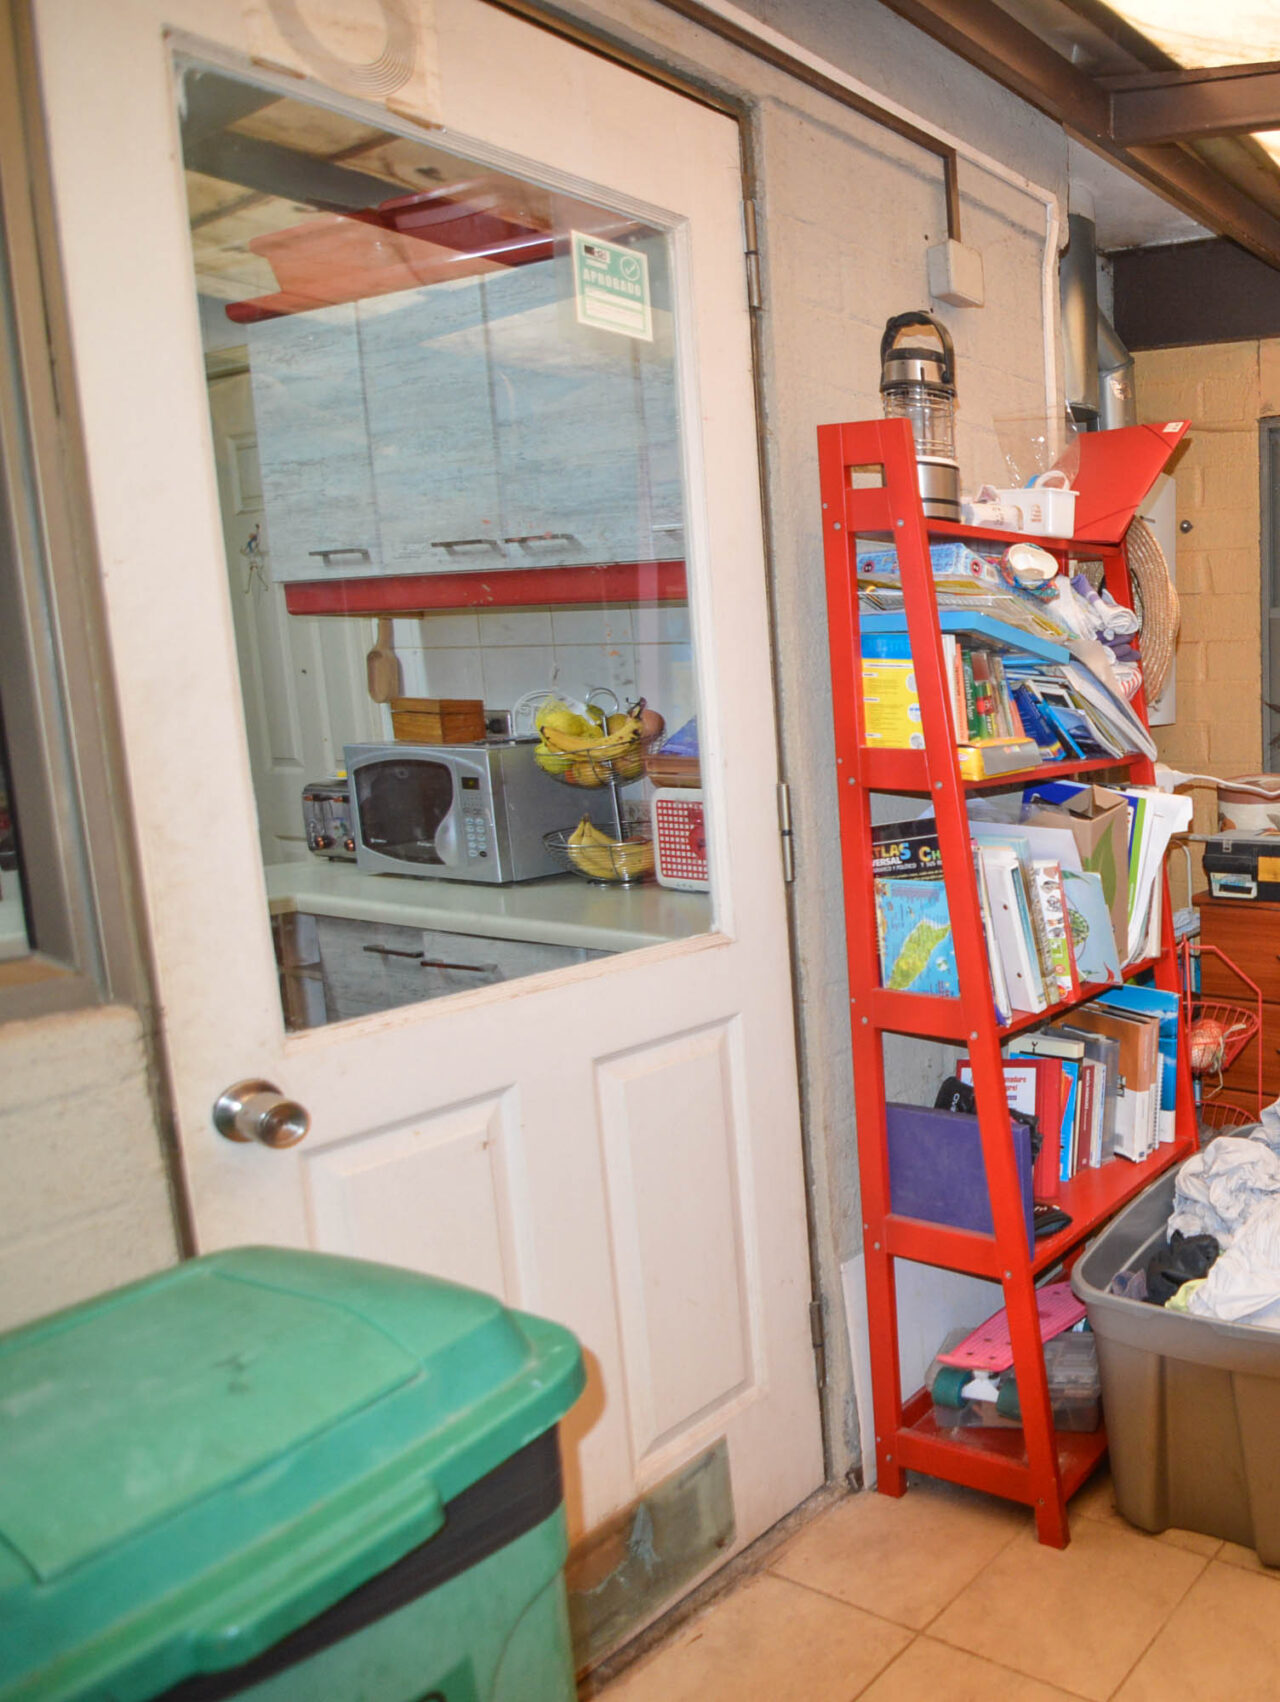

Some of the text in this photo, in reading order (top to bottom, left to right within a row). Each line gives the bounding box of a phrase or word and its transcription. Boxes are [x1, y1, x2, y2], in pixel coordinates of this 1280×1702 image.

[583, 267, 642, 297] APROBADO
[963, 664, 974, 720] Cambridge
[872, 857, 903, 867] VERSAL
[918, 846, 941, 862] CH
